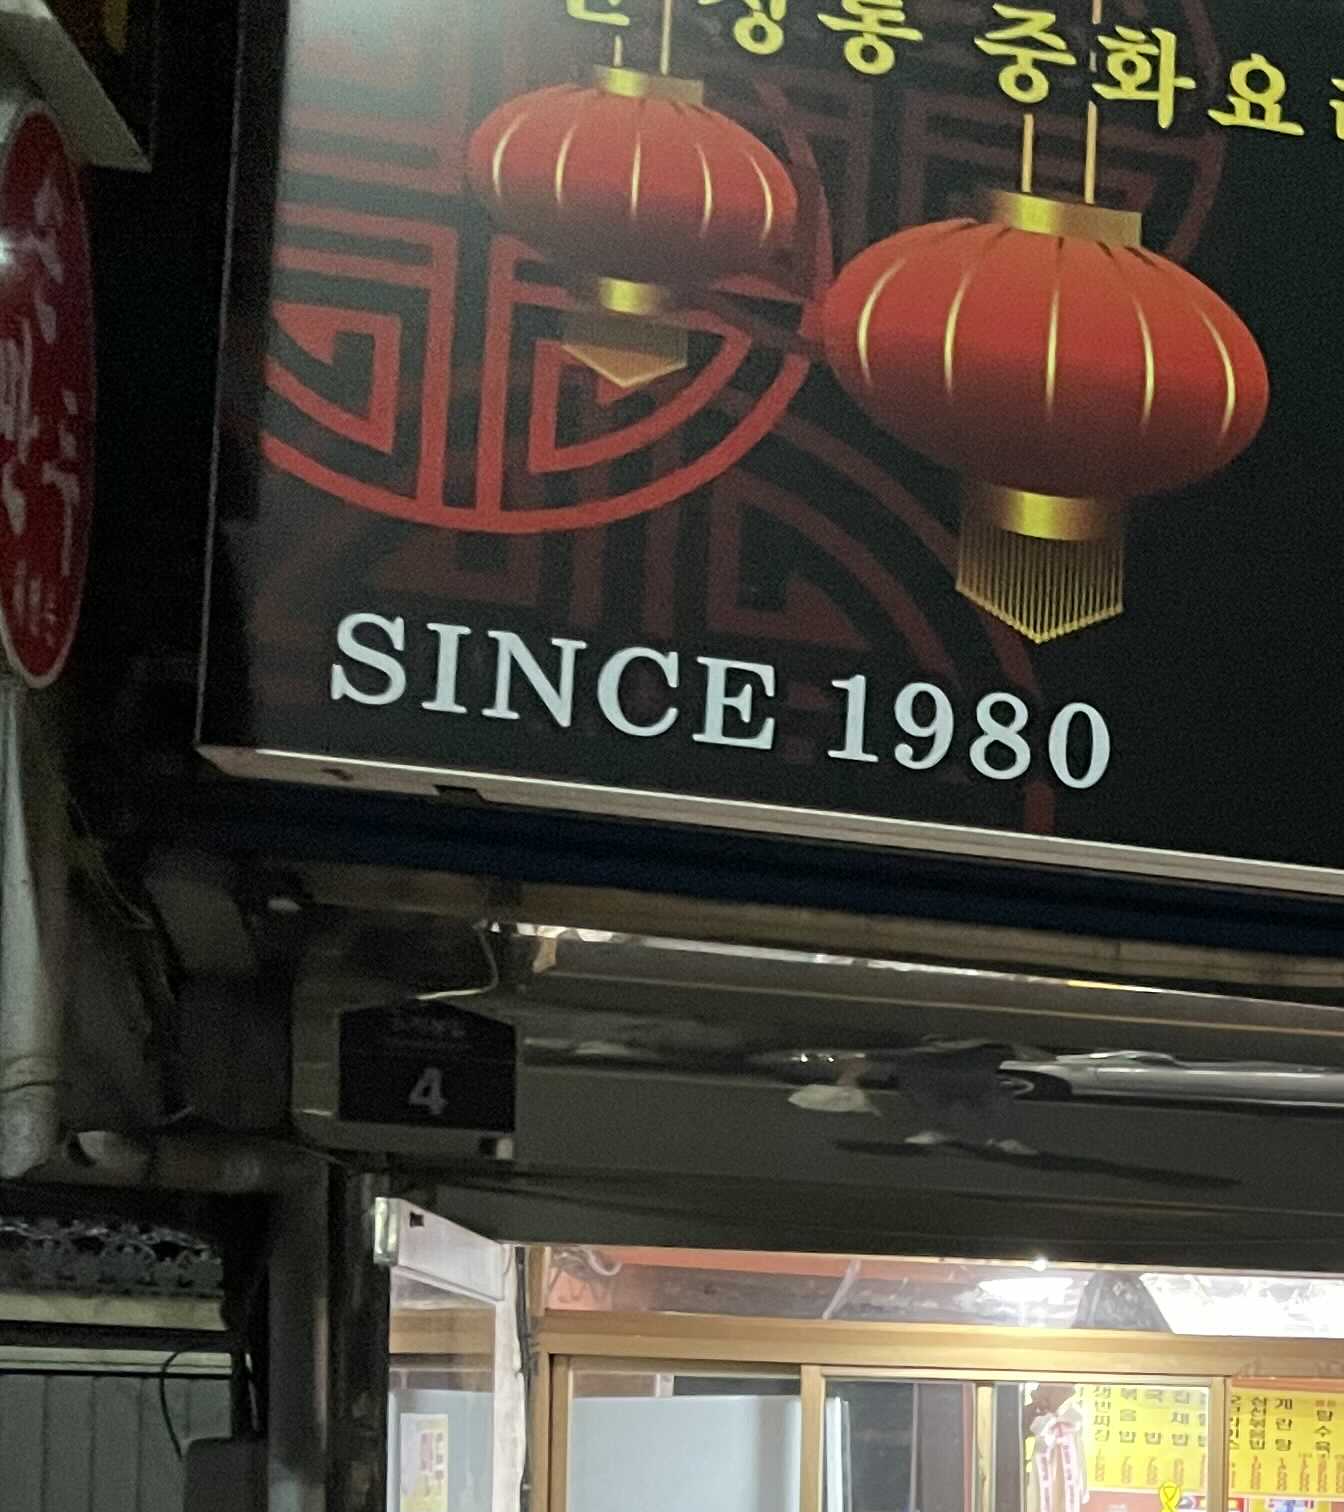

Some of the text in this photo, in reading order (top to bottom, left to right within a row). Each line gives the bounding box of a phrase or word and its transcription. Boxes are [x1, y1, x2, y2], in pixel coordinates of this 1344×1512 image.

[330, 614, 1112, 790] SINCE 1980
[408, 1067, 448, 1115] 4
